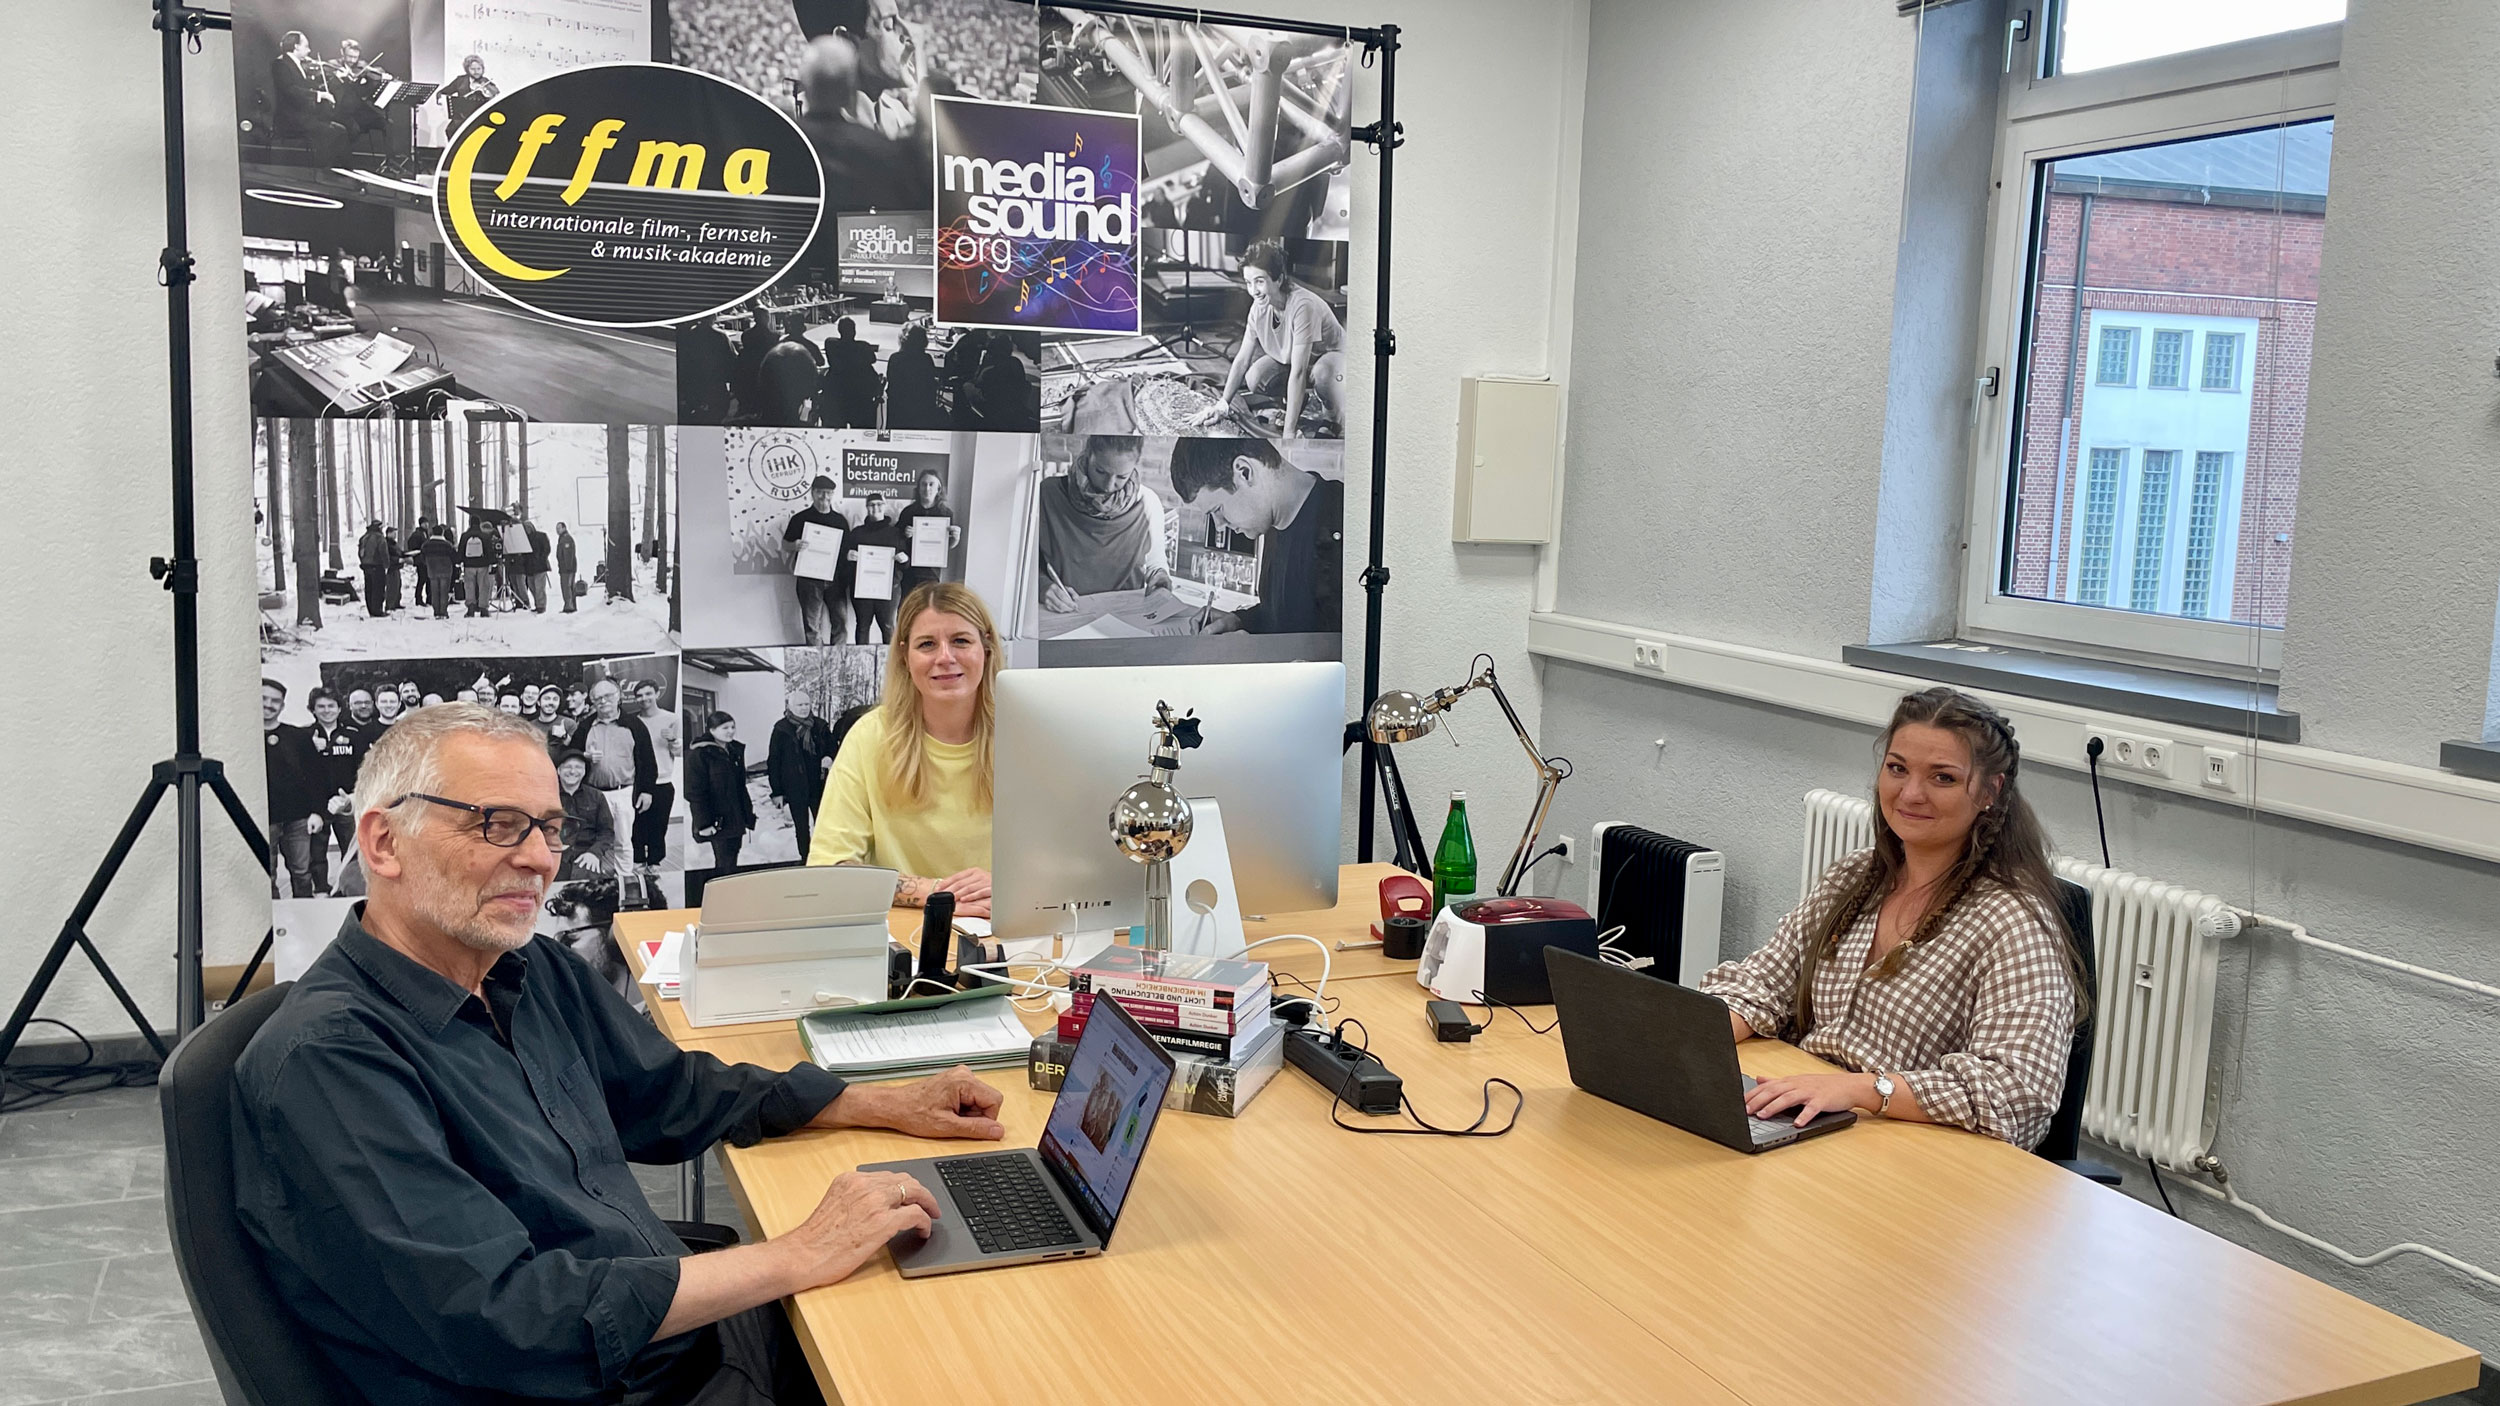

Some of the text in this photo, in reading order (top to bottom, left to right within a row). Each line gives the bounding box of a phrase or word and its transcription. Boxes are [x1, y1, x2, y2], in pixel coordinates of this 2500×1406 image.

[944, 151, 1095, 203] media
[489, 209, 778, 244] internationale film-, fernseh-
[967, 192, 1132, 245] sound
[849, 224, 896, 241] media
[591, 240, 773, 267] & musik-akademie
[856, 235, 914, 255] sound
[949, 235, 1011, 273] .org
[847, 452, 898, 470] Prüfung
[847, 467, 916, 482] bestanden!
[770, 480, 810, 498] RUHR
[332, 745, 353, 756] HUM
[1111, 987, 1165, 1000] BELEUCHTUNG
[1136, 982, 1195, 995] MEDIENBEREICH
[1166, 994, 1182, 1002] UND
[1184, 996, 1206, 1005] LICHT
[1152, 1034, 1222, 1051] ENTARFILMREGIE
[1034, 1061, 1196, 1095] DER ILM
